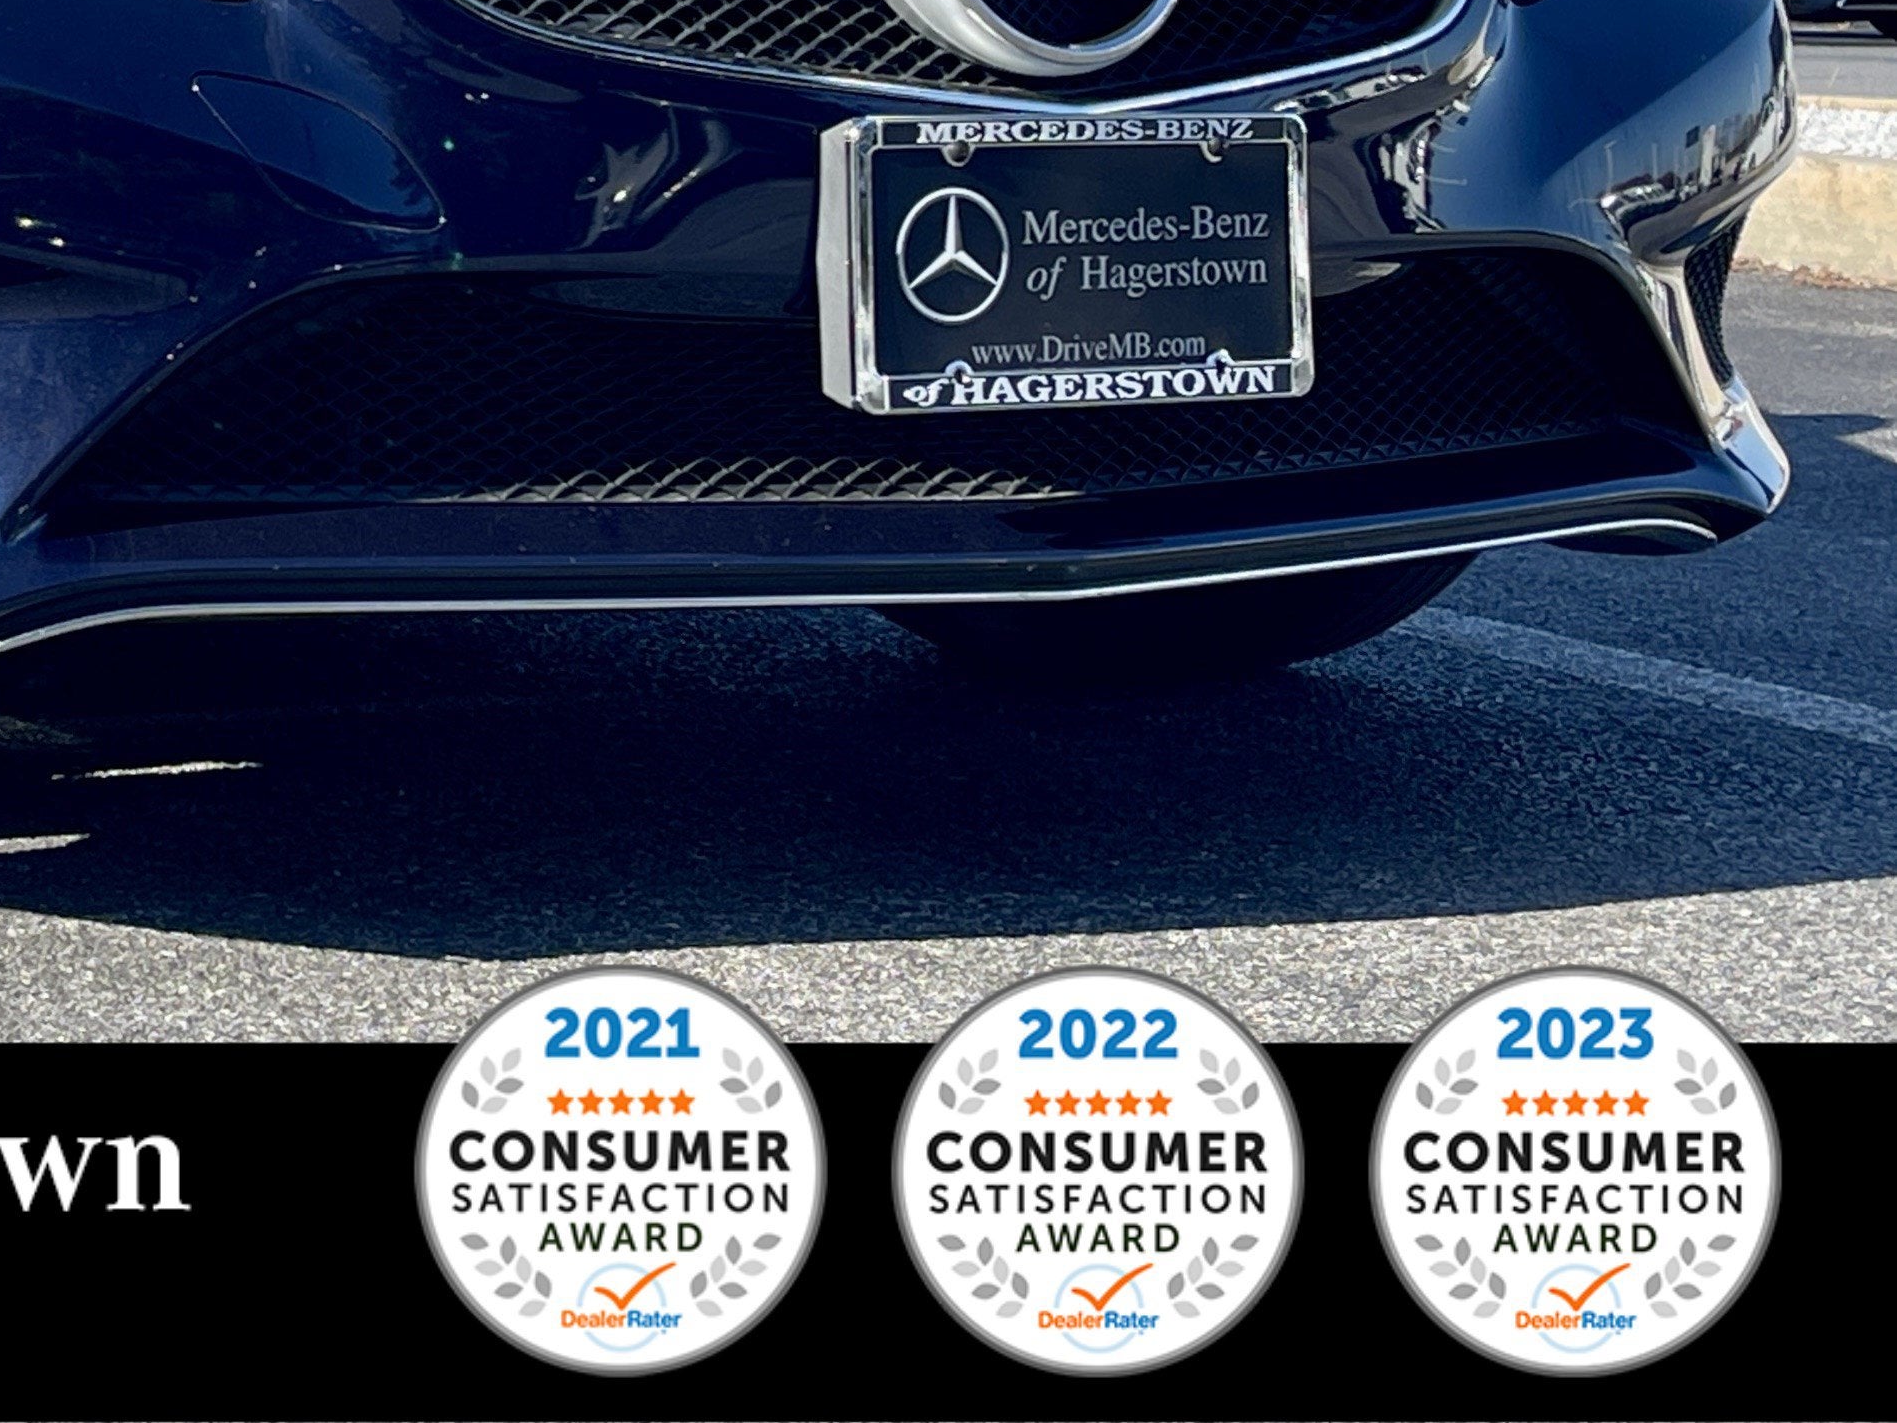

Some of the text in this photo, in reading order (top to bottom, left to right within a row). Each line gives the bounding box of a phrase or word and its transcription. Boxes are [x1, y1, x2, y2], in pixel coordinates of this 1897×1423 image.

[916, 118, 1255, 144] MERCEDES-BENZ
[1021, 204, 1270, 246] Mercedes-Benz
[1026, 254, 1268, 301] of Hagerstown
[970, 331, 1205, 365] www.DriveMB.com
[903, 365, 1276, 407] of HAGERSTOWN
